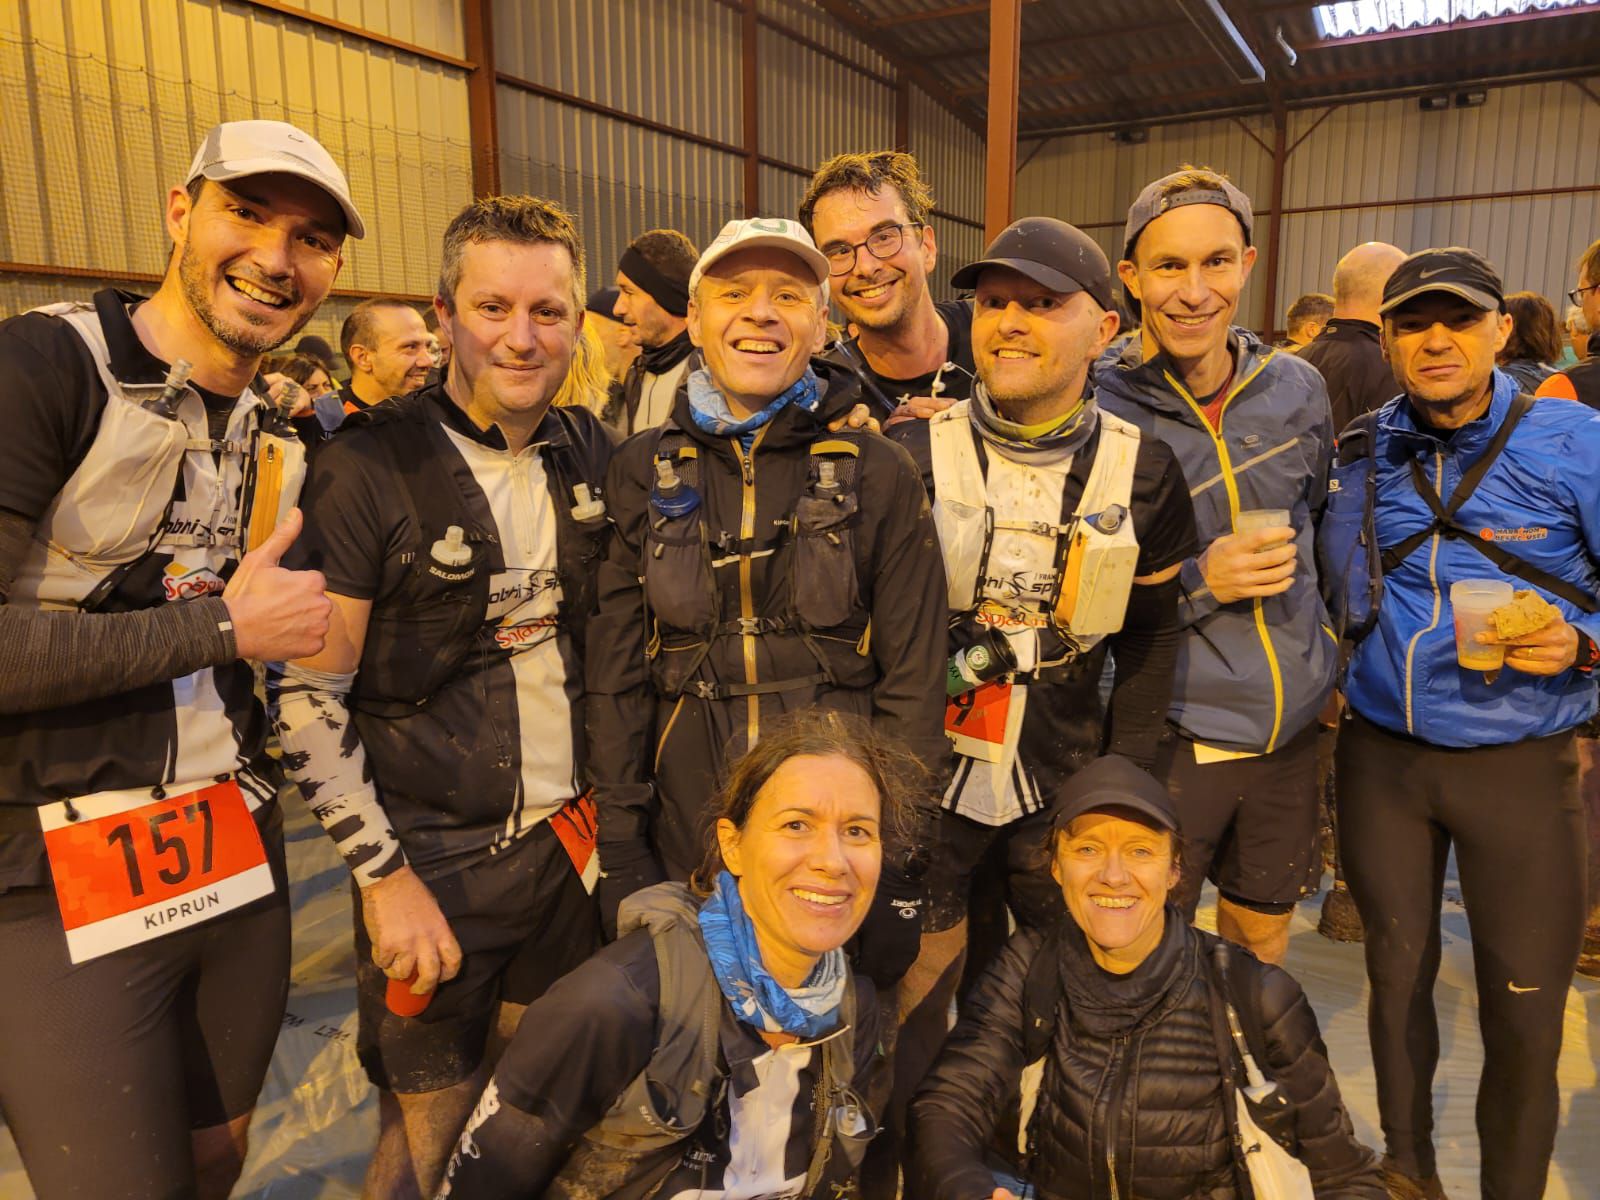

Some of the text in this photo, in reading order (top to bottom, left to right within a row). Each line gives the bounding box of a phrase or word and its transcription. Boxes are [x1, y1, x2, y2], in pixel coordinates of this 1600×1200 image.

[428, 566, 475, 581] SALOMON
[106, 799, 215, 897] 157
[143, 891, 220, 930] KIPRUN
